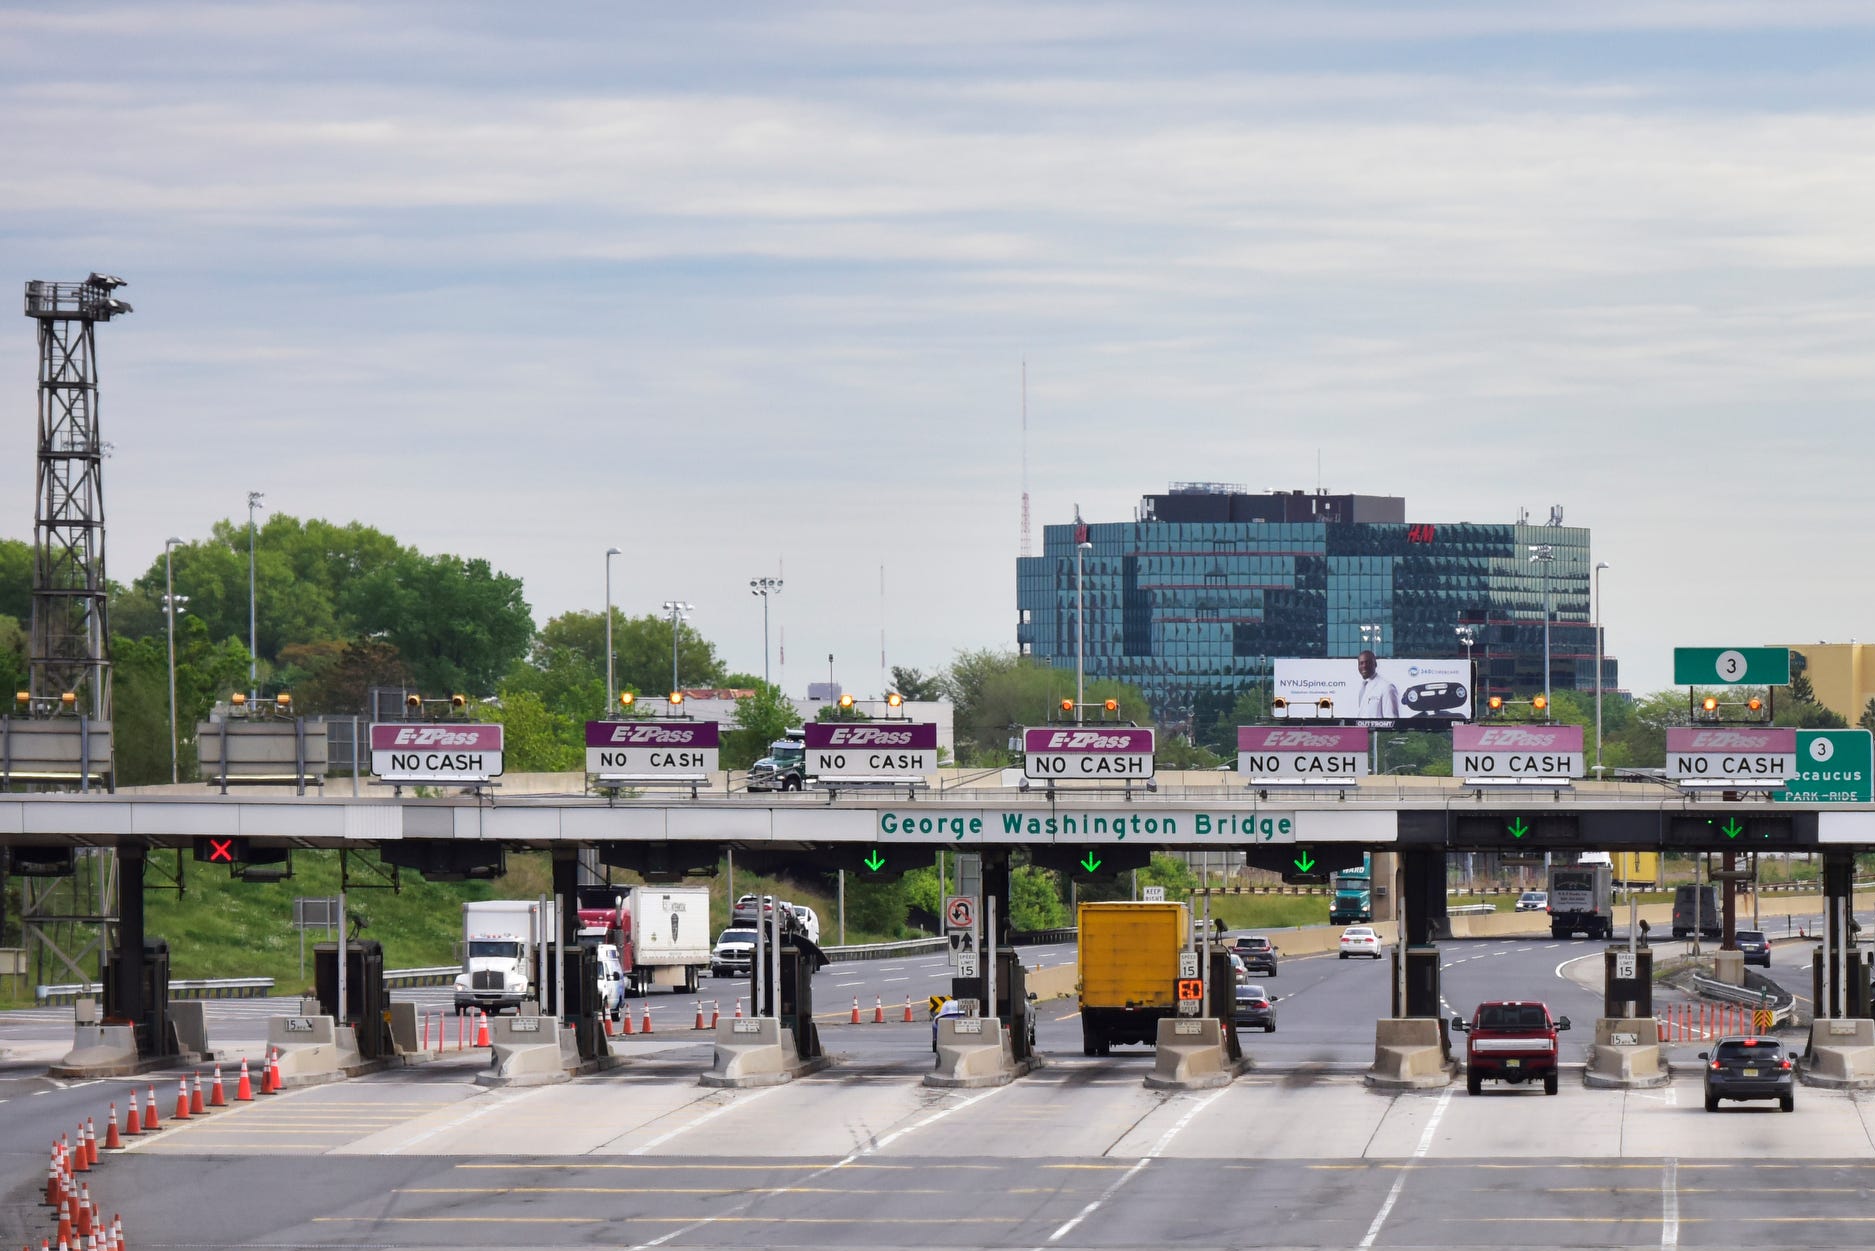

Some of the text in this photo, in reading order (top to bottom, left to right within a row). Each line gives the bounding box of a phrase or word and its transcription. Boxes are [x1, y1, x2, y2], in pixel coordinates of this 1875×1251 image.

[1727, 659, 1736, 673] 3
[1280, 680, 1346, 688] NYNJSpine.com
[1818, 743, 1826, 755] 3
[392, 755, 482, 770] NO CASH
[601, 753, 703, 767] NO CASH
[820, 755, 922, 768] NO CASH
[1037, 757, 1142, 773] NO CASH
[1251, 756, 1355, 772] NO CASH
[1466, 756, 1570, 772] NO CASH
[1679, 757, 1783, 773] NO CASH
[1795, 771, 1862, 781] ecaucus
[882, 812, 1291, 840] George Washington Bridge
[961, 966, 974, 976] 15
[1183, 966, 1195, 976] 15
[1620, 966, 1633, 976] 15
[287, 1020, 296, 1030] 15
[1612, 1035, 1621, 1045] 15
